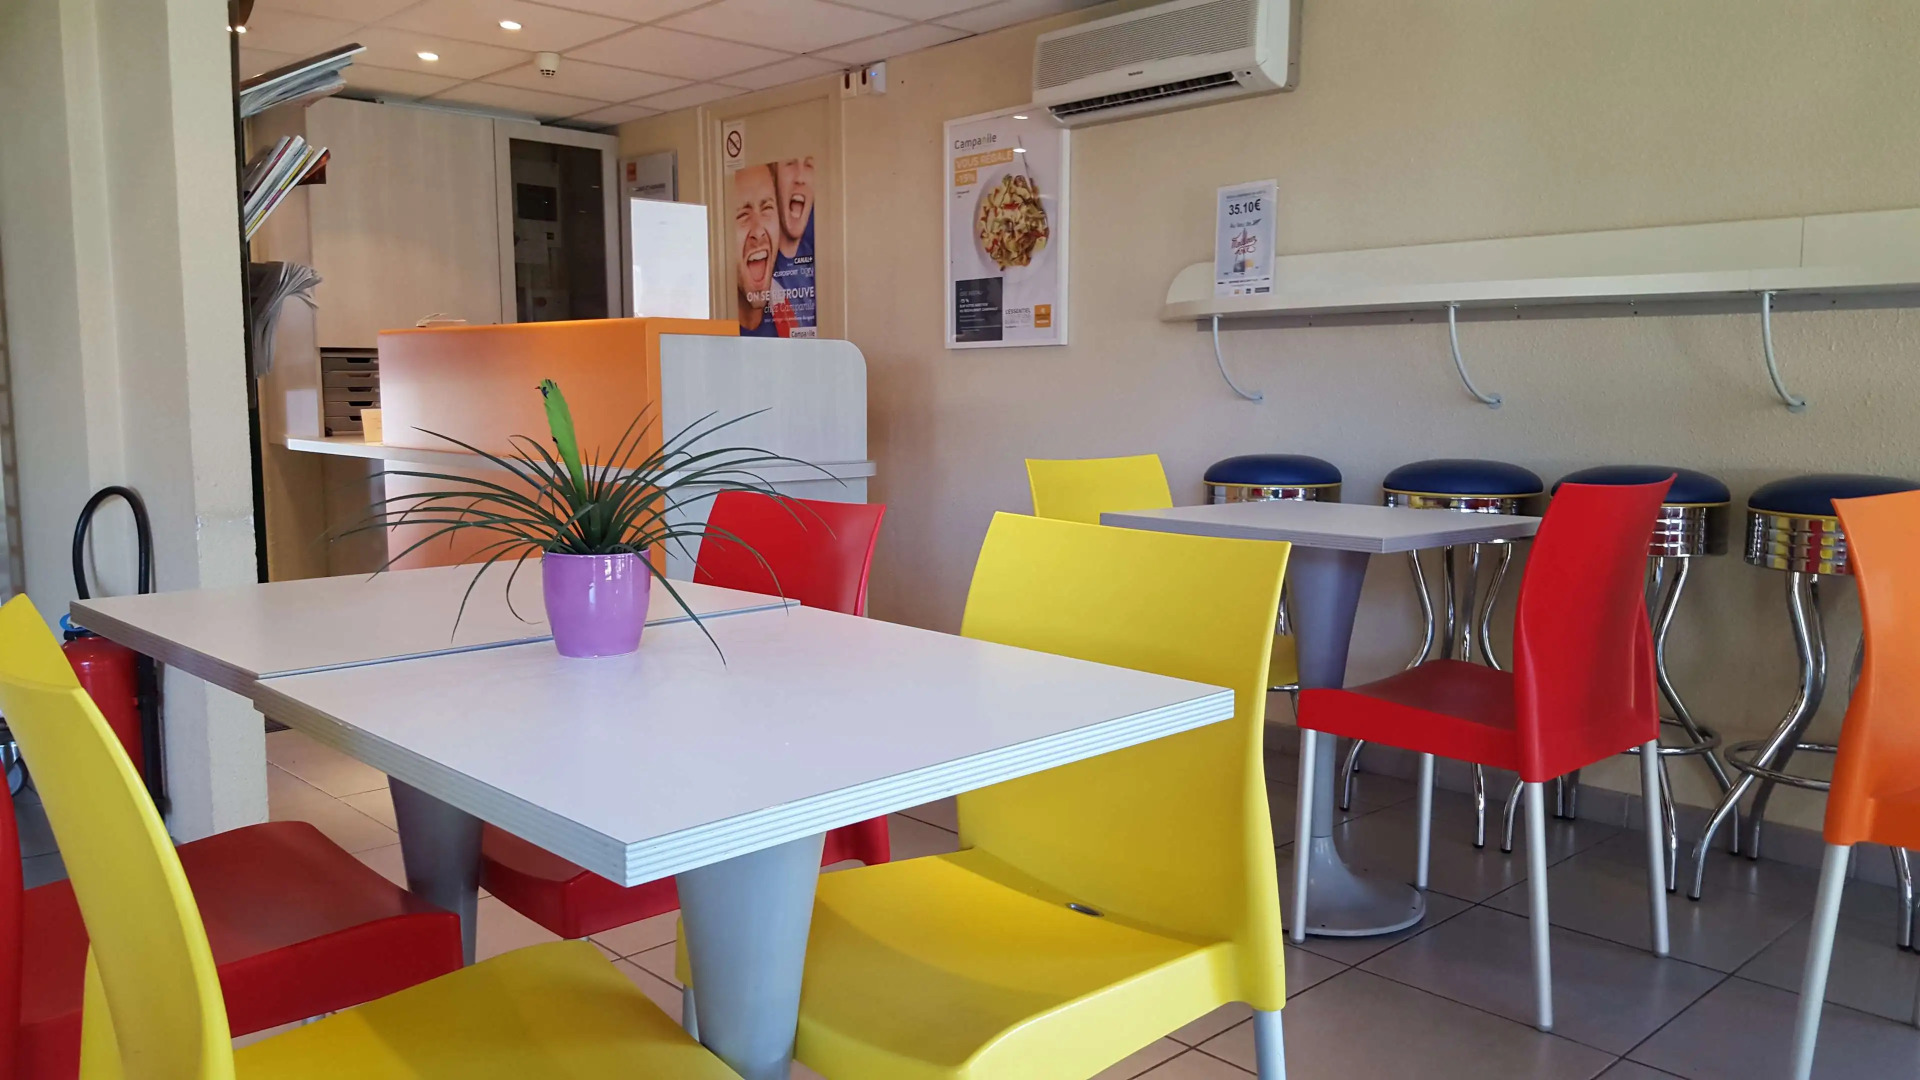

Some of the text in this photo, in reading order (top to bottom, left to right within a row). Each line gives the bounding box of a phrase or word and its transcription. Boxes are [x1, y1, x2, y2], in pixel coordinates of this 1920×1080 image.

[956, 157, 979, 170] VOUS
[1229, 198, 1261, 216] 35.10€
[747, 291, 759, 302] ON
[760, 290, 770, 301] SE
